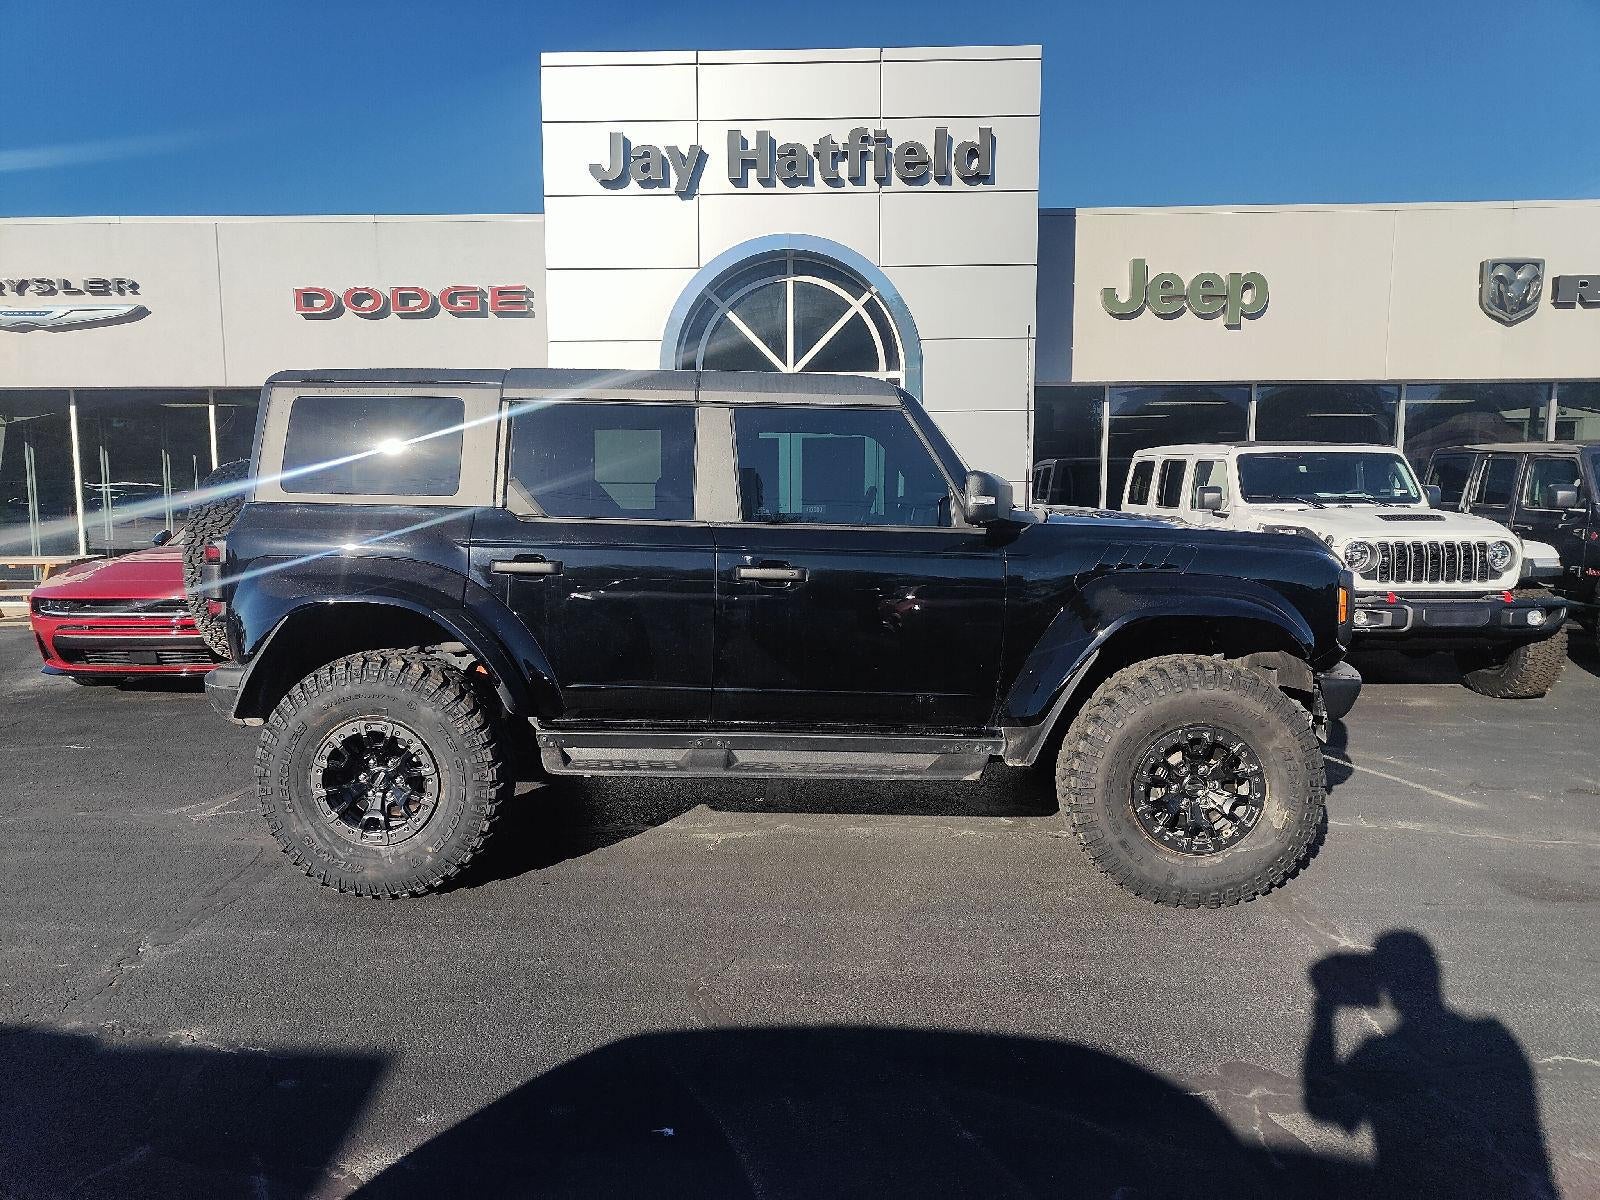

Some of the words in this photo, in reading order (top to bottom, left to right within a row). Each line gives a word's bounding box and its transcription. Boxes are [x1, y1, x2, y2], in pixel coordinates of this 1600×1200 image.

[588, 131, 707, 199] Jay
[727, 126, 996, 188] Hatfield
[293, 285, 533, 319] DODGE
[1101, 258, 1269, 329] Jeep
